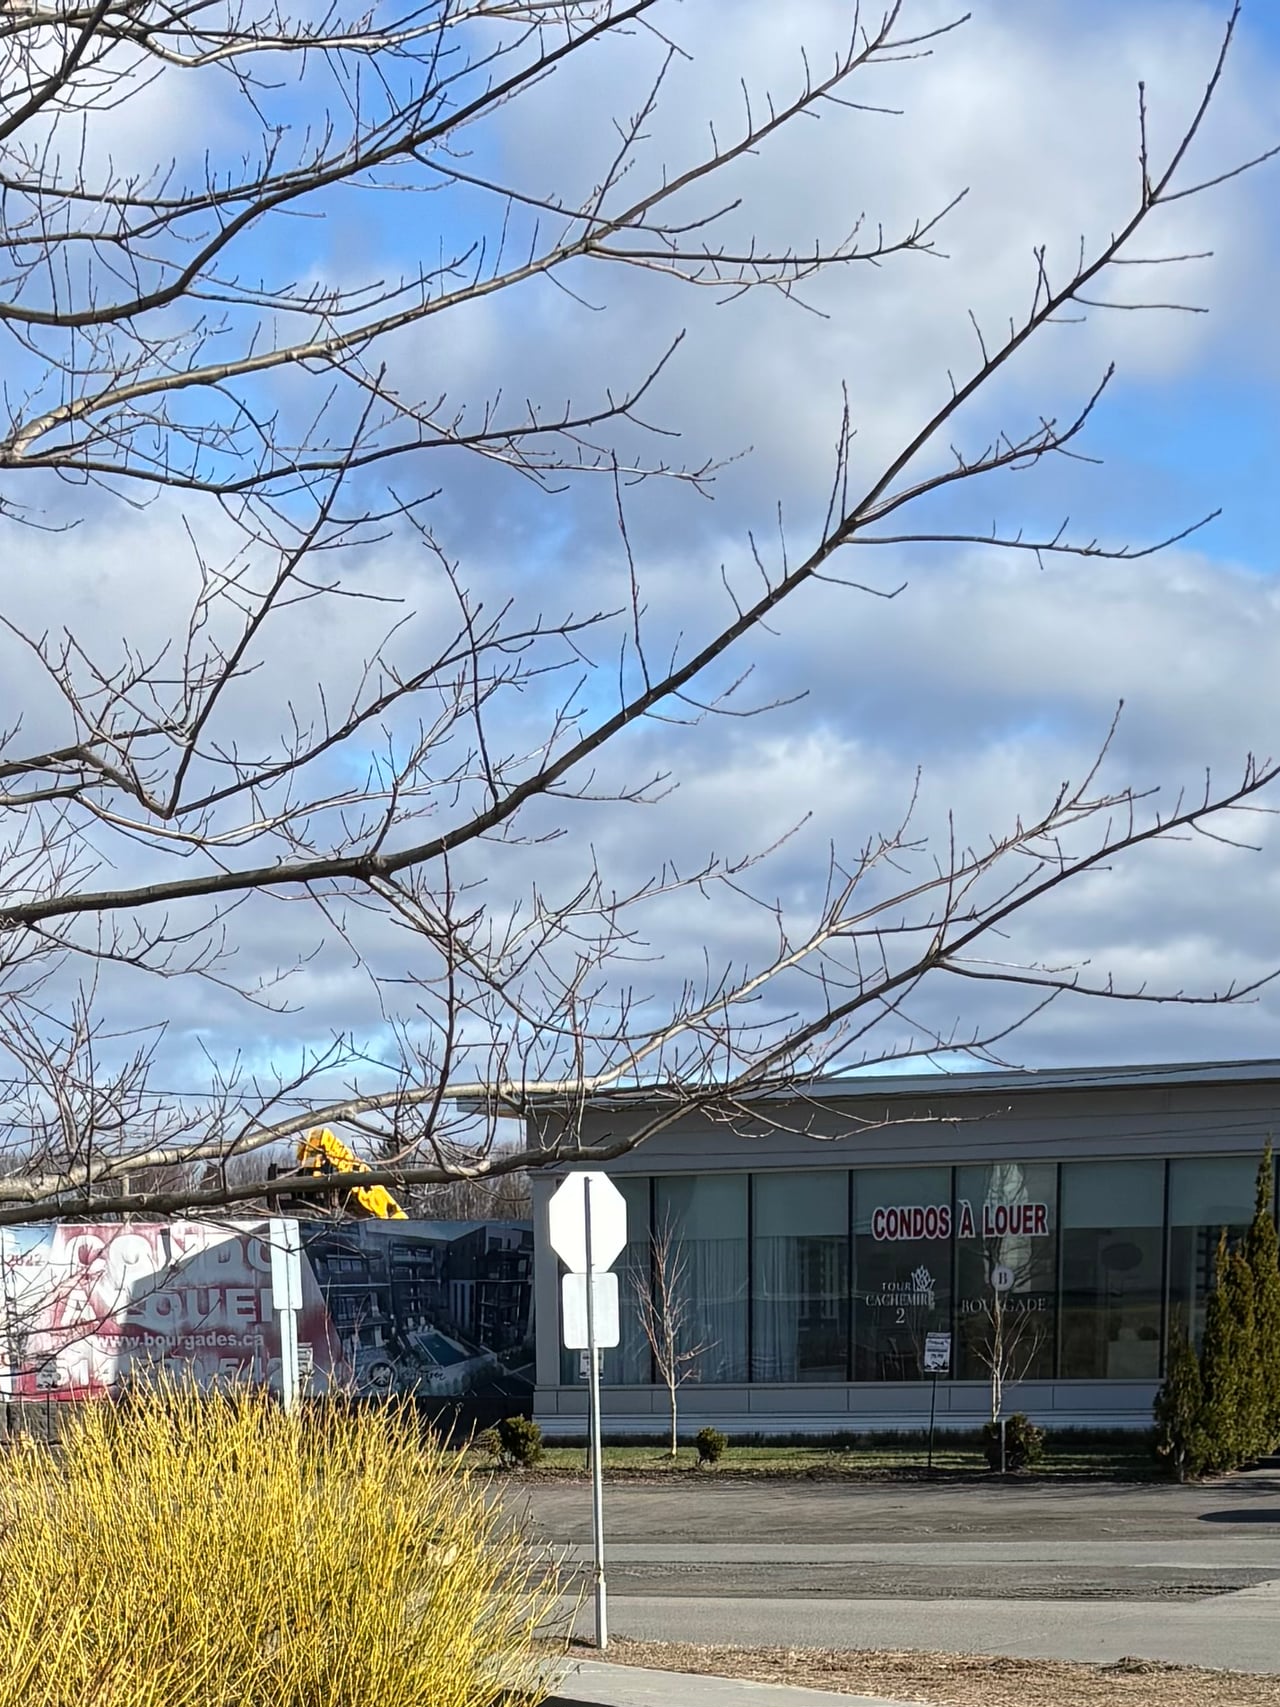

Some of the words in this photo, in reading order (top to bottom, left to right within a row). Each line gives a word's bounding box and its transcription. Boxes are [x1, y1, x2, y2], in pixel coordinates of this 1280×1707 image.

[873, 1205, 951, 1240] CONDOS
[959, 1199, 976, 1238] À
[983, 1203, 1049, 1236] LOUER
[998, 1272, 1008, 1285] B
[882, 1282, 912, 1291] TOUR
[866, 1293, 936, 1309] CACHEMIRE
[895, 1309, 906, 1324] 2
[96, 1331, 265, 1350] www.bourgades.ca
